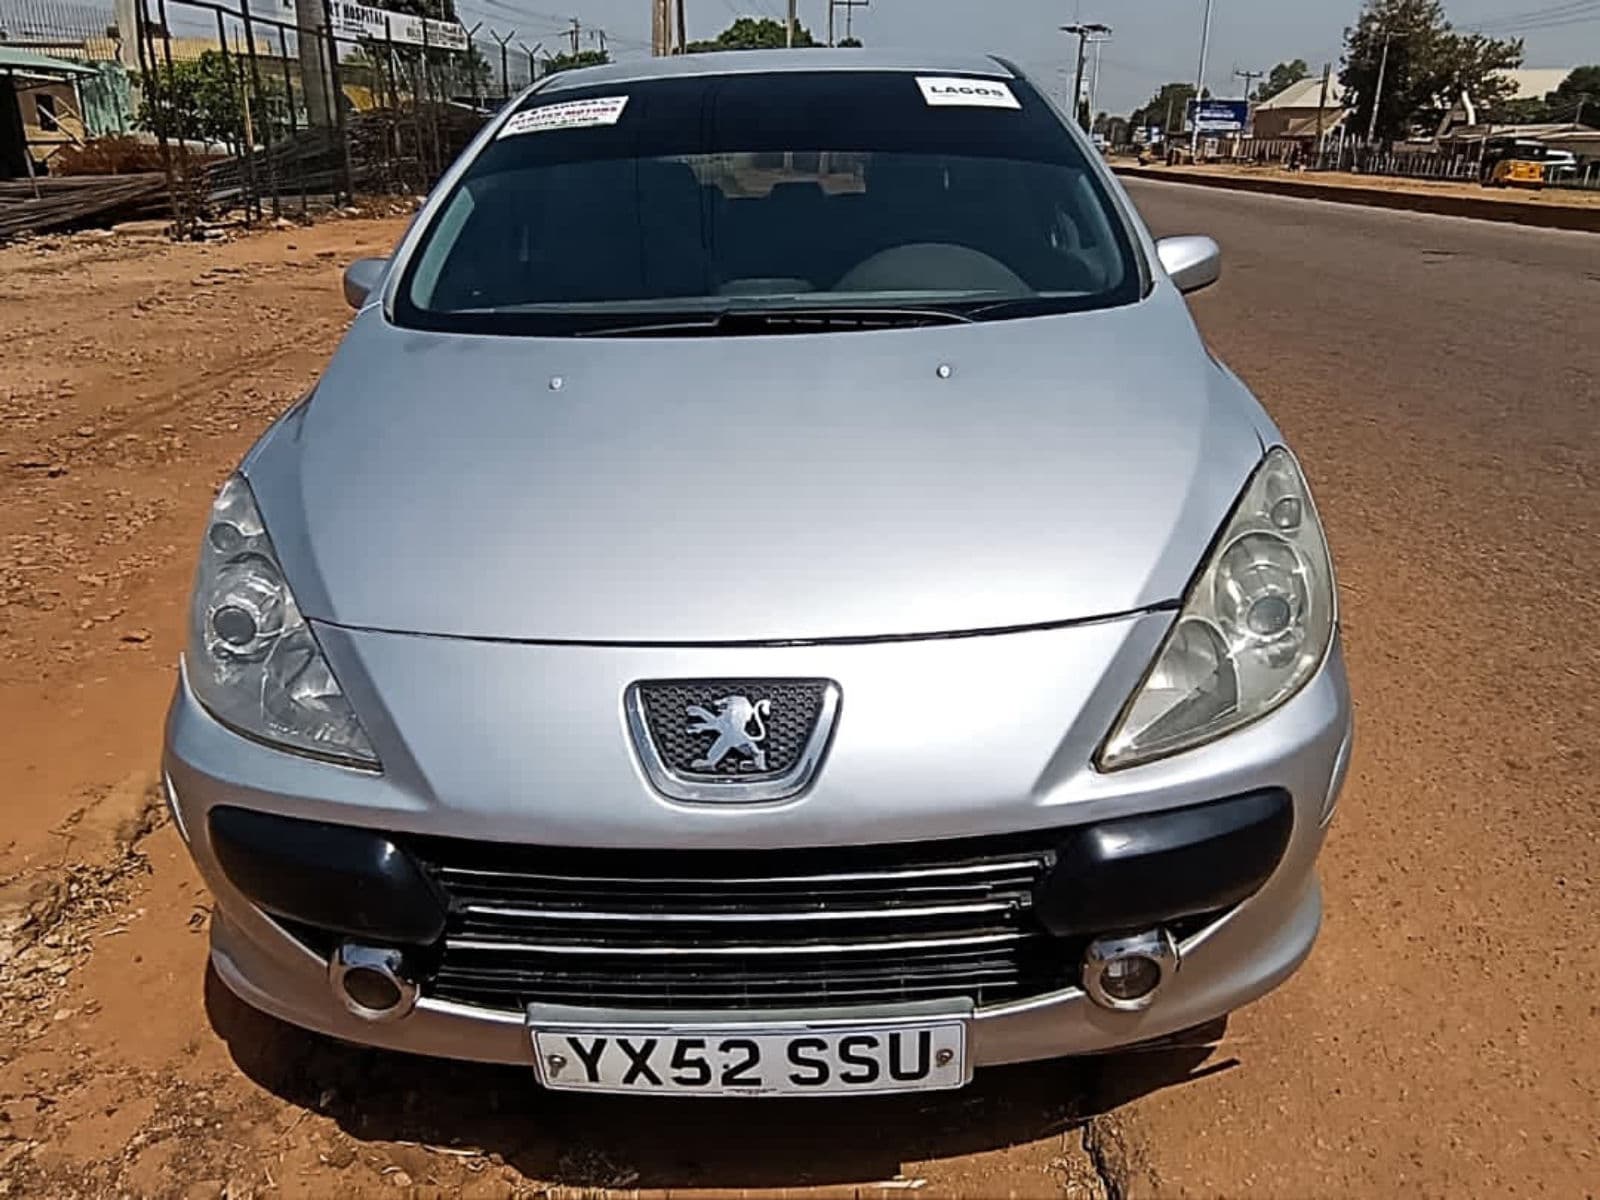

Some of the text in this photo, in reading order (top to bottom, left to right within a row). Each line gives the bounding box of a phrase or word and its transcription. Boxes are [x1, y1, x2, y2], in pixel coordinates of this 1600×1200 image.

[343, 3, 385, 25] HOSPITAL
[930, 86, 1004, 96] LAGOS
[566, 1030, 932, 1086] YX52 SSU
